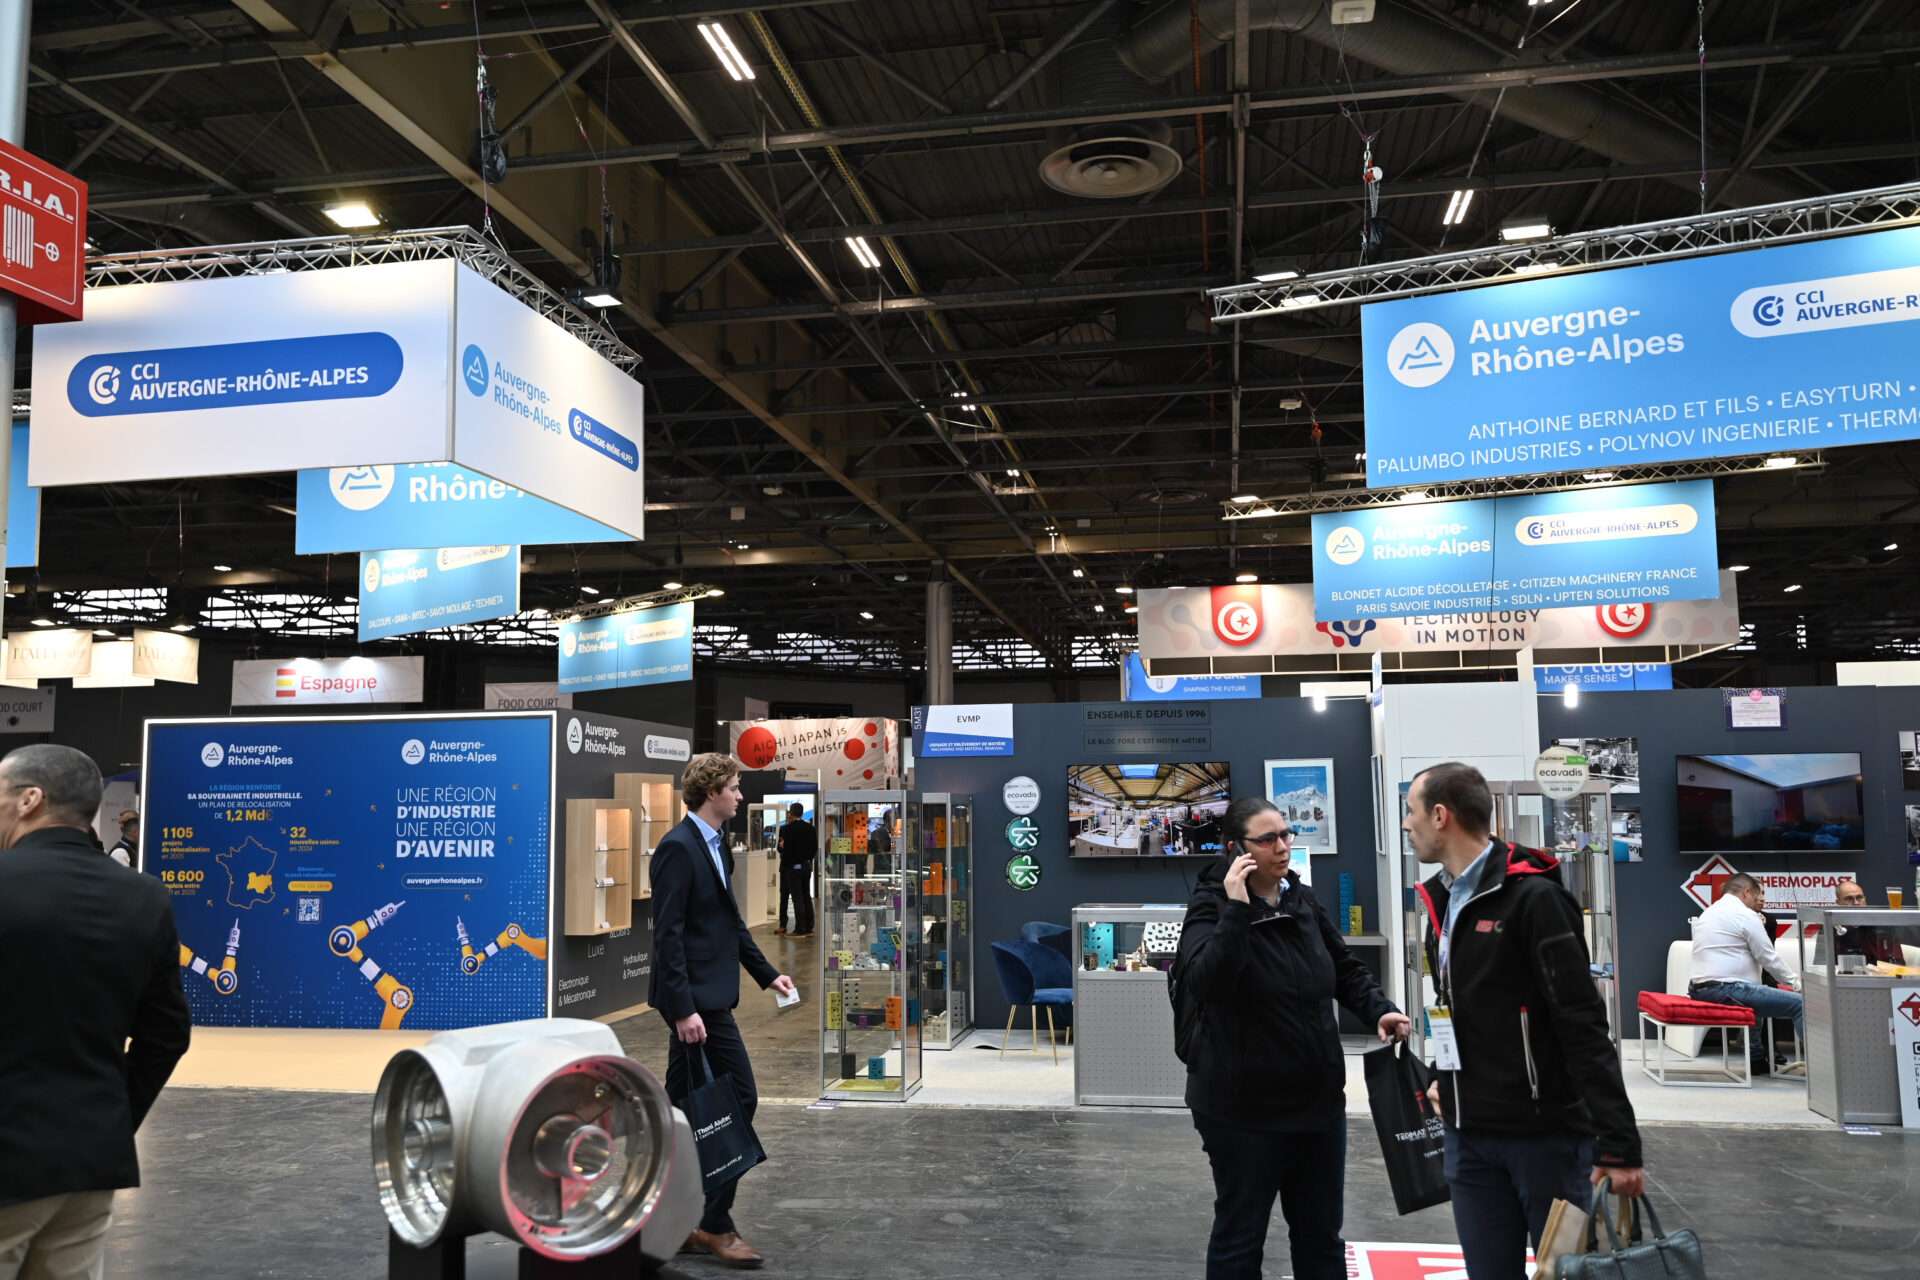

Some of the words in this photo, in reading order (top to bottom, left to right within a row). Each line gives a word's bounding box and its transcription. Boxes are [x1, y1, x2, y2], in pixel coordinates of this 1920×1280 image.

[1795, 289, 1825, 307] CCI
[1795, 294, 1920, 321] AUVERGNE-R
[1468, 304, 1641, 346] Auvergne-
[1471, 329, 1685, 376] Rhône-Alpes
[131, 363, 160, 382] CCI
[129, 366, 369, 401] AUVERGNE-RHÔNE-ALPES
[494, 361, 550, 404] Auvergne-
[494, 384, 562, 435] Rhône-Alpes
[1468, 414, 1574, 441] ANTHOINE
[1578, 404, 1677, 430] BERNARD
[1683, 400, 1708, 419] ET
[1715, 395, 1760, 416] FILS
[1780, 380, 1901, 409] EASYTURN
[1377, 451, 1466, 475] PALUMBO
[1470, 440, 1582, 466] INDUSTRIES
[1599, 428, 1696, 454] POLYNOV
[1701, 416, 1820, 444] INGENIERIE
[1839, 407, 1920, 432] THERM
[409, 472, 525, 503] Rhône-
[1372, 539, 1491, 561] Rhône-Alpes
[1331, 588, 1381, 602] BLONDET
[1385, 585, 1425, 598] ALCIDE
[1427, 580, 1510, 596] DÉCOLLETAGE
[1519, 575, 1567, 590] CITIZEN
[1569, 571, 1643, 586] MACHINERY
[1646, 567, 1698, 581] FRANCE
[1356, 603, 1388, 615] PARIS
[1391, 600, 1431, 612] SAVOIE
[1433, 596, 1500, 610] INDUSTRIES
[1511, 594, 1543, 606] SDLN
[1553, 590, 1593, 603] UPTEN
[1596, 584, 1671, 600] SOLUTIONS
[1417, 630, 1436, 643] IN
[1446, 628, 1526, 643] MOTION
[300, 674, 377, 693] Espagne
[1544, 674, 1582, 684] MAKES
[1584, 673, 1618, 684] SENSE
[12, 701, 43, 713] COURT
[498, 698, 525, 709] FOOD
[527, 697, 560, 708] COURT
[956, 715, 981, 723] EVMP
[1087, 710, 1143, 720] ENSEMBLE
[1145, 709, 1183, 719] DEPUIS
[1185, 709, 1206, 718] 1996
[585, 721, 620, 740] Auvergne-
[228, 743, 282, 755] Auvergne-
[429, 740, 485, 752] Auvergne-
[584, 738, 627, 758] Rhône-Alpes
[753, 738, 787, 753] AICHI
[792, 728, 833, 746] JAPAN
[227, 755, 294, 767] Rhône-Alpes
[429, 752, 497, 764] Rhône-Alpes
[754, 751, 795, 765] Where
[1538, 767, 1583, 777] ecovadis
[397, 787, 430, 803] UNE
[434, 783, 497, 803] RÉGION
[214, 812, 223, 820] DE
[225, 809, 243, 822] 1,2
[397, 805, 497, 819] D'INDUSTRIE
[290, 826, 307, 838] 32
[396, 821, 429, 837] UNE
[433, 819, 497, 837] RÉGION
[396, 839, 496, 858] D'AVENIR
[160, 870, 176, 882] 16
[177, 870, 204, 882] 600
[587, 944, 605, 958] Luxe
